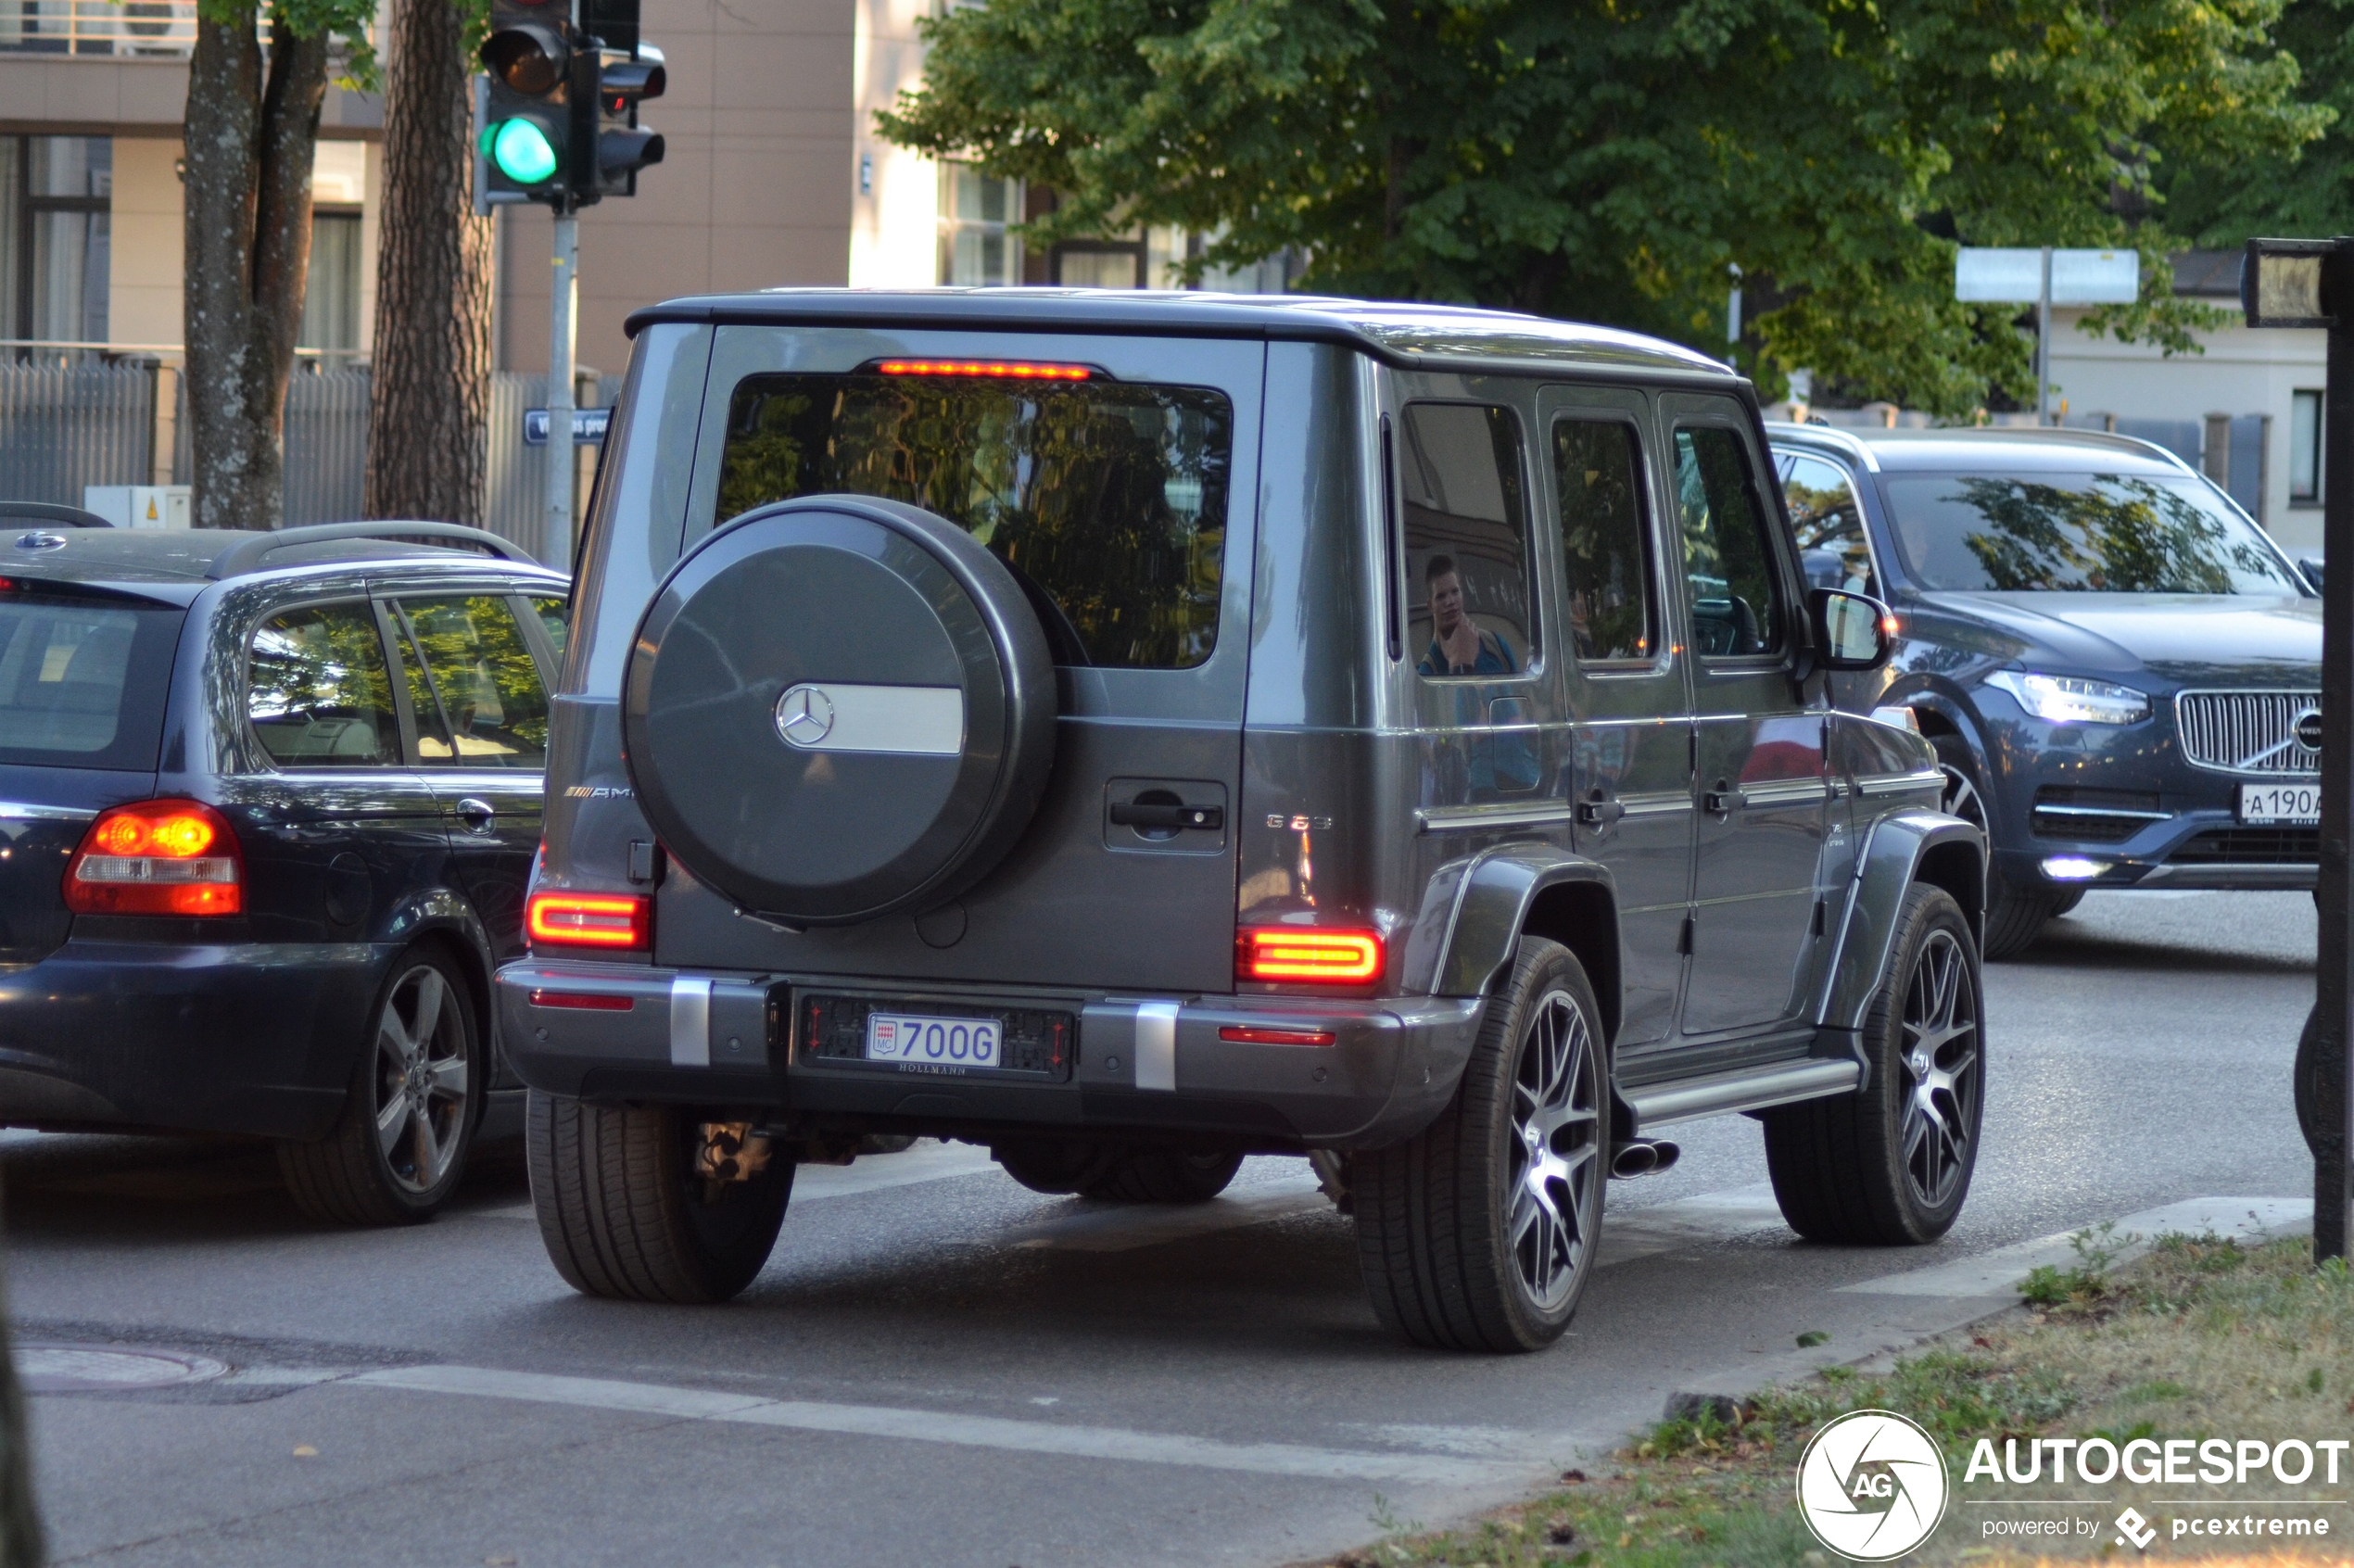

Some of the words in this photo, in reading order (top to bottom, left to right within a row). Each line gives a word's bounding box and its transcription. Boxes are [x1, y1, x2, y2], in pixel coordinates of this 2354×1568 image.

[590, 786, 635, 799] AM
[877, 1039, 892, 1049] MC
[903, 1022, 993, 1060] 700G
[899, 1064, 966, 1075] HOLLMANN
